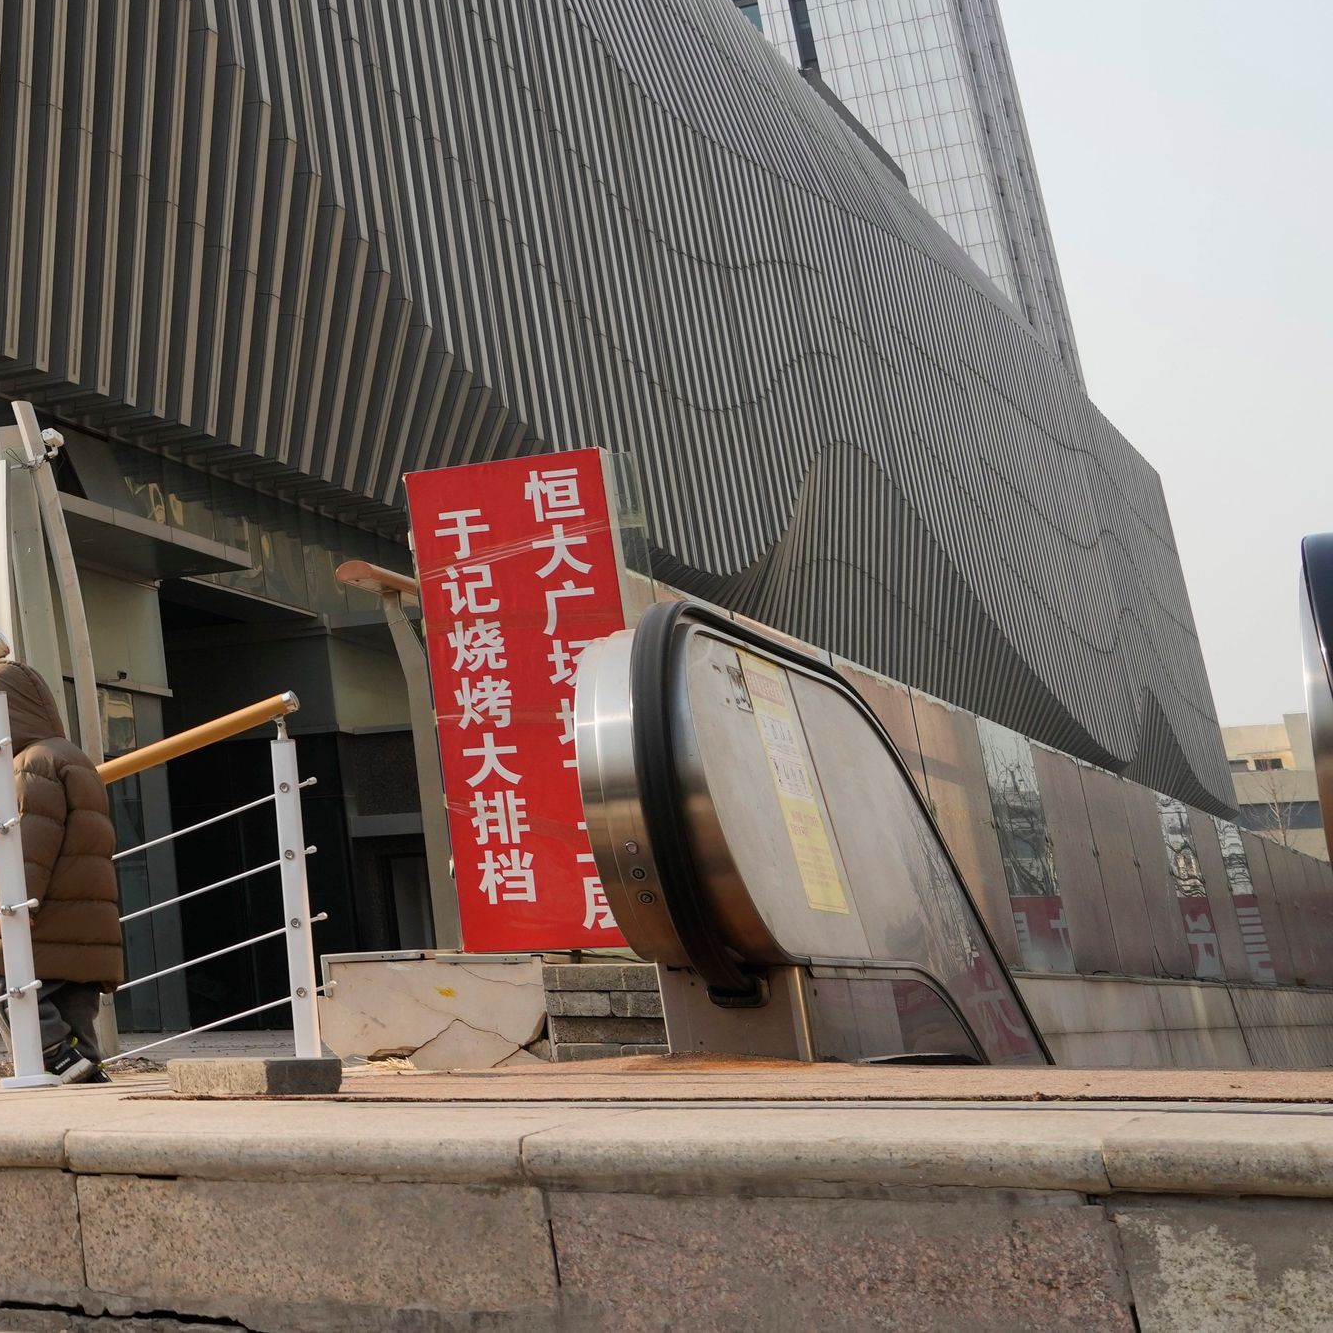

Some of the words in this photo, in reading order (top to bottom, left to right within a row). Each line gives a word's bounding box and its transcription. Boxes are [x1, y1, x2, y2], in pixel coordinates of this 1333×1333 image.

[435, 509, 537, 904] 于记烧烤大排档
